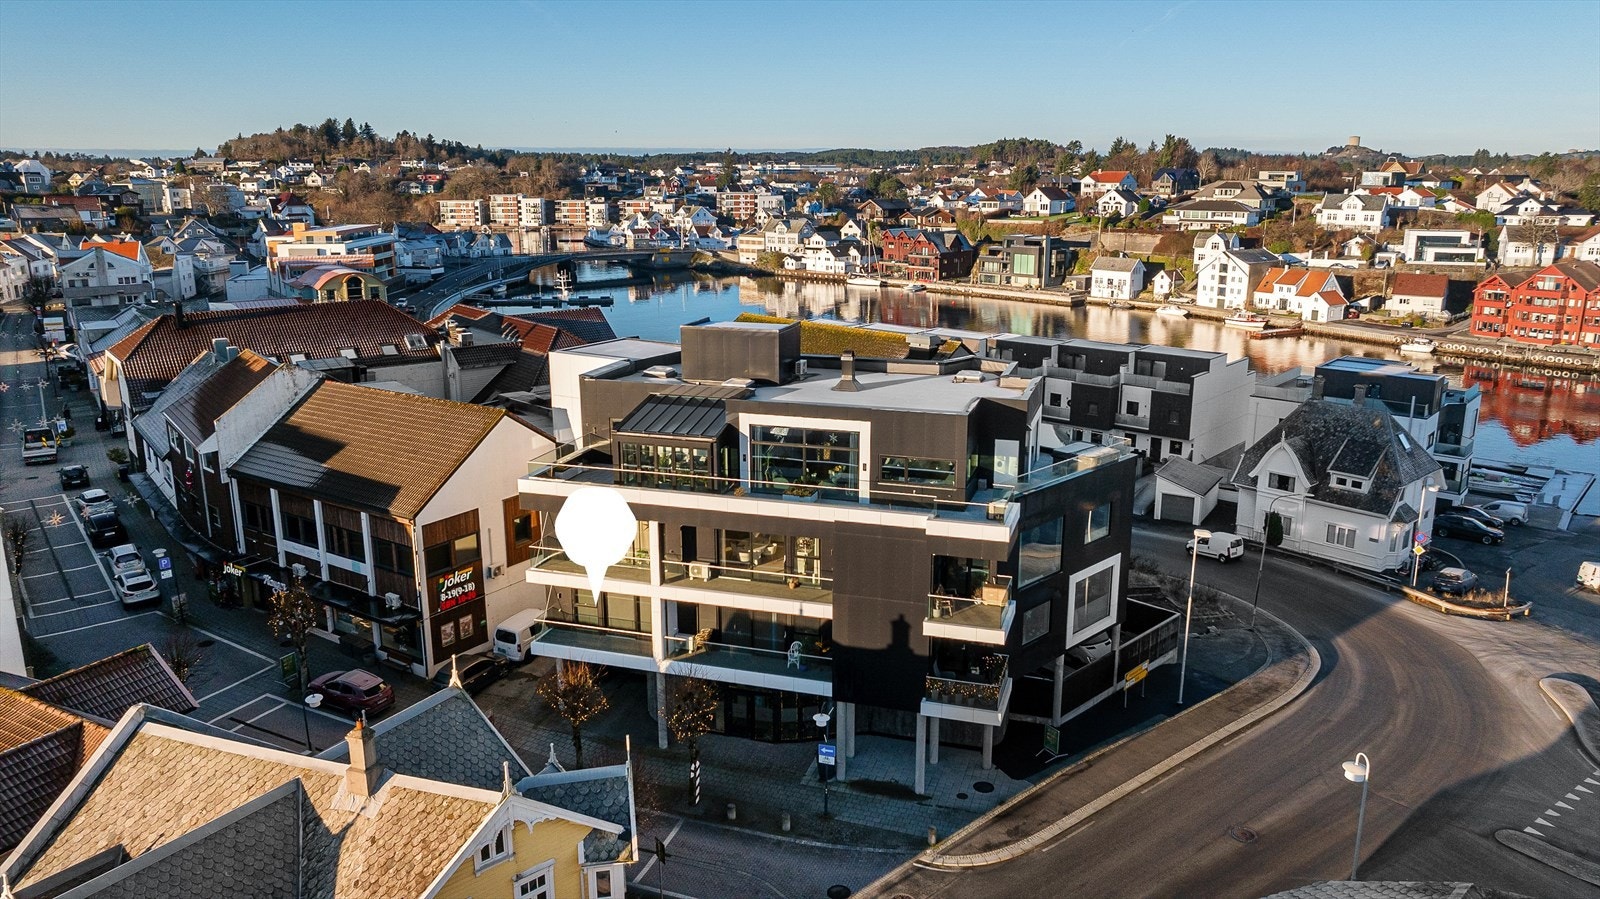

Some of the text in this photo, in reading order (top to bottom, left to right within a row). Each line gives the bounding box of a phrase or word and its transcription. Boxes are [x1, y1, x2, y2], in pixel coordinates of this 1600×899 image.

[161, 559, 168, 568] P
[223, 563, 243, 576] joker
[442, 571, 472, 592] joker
